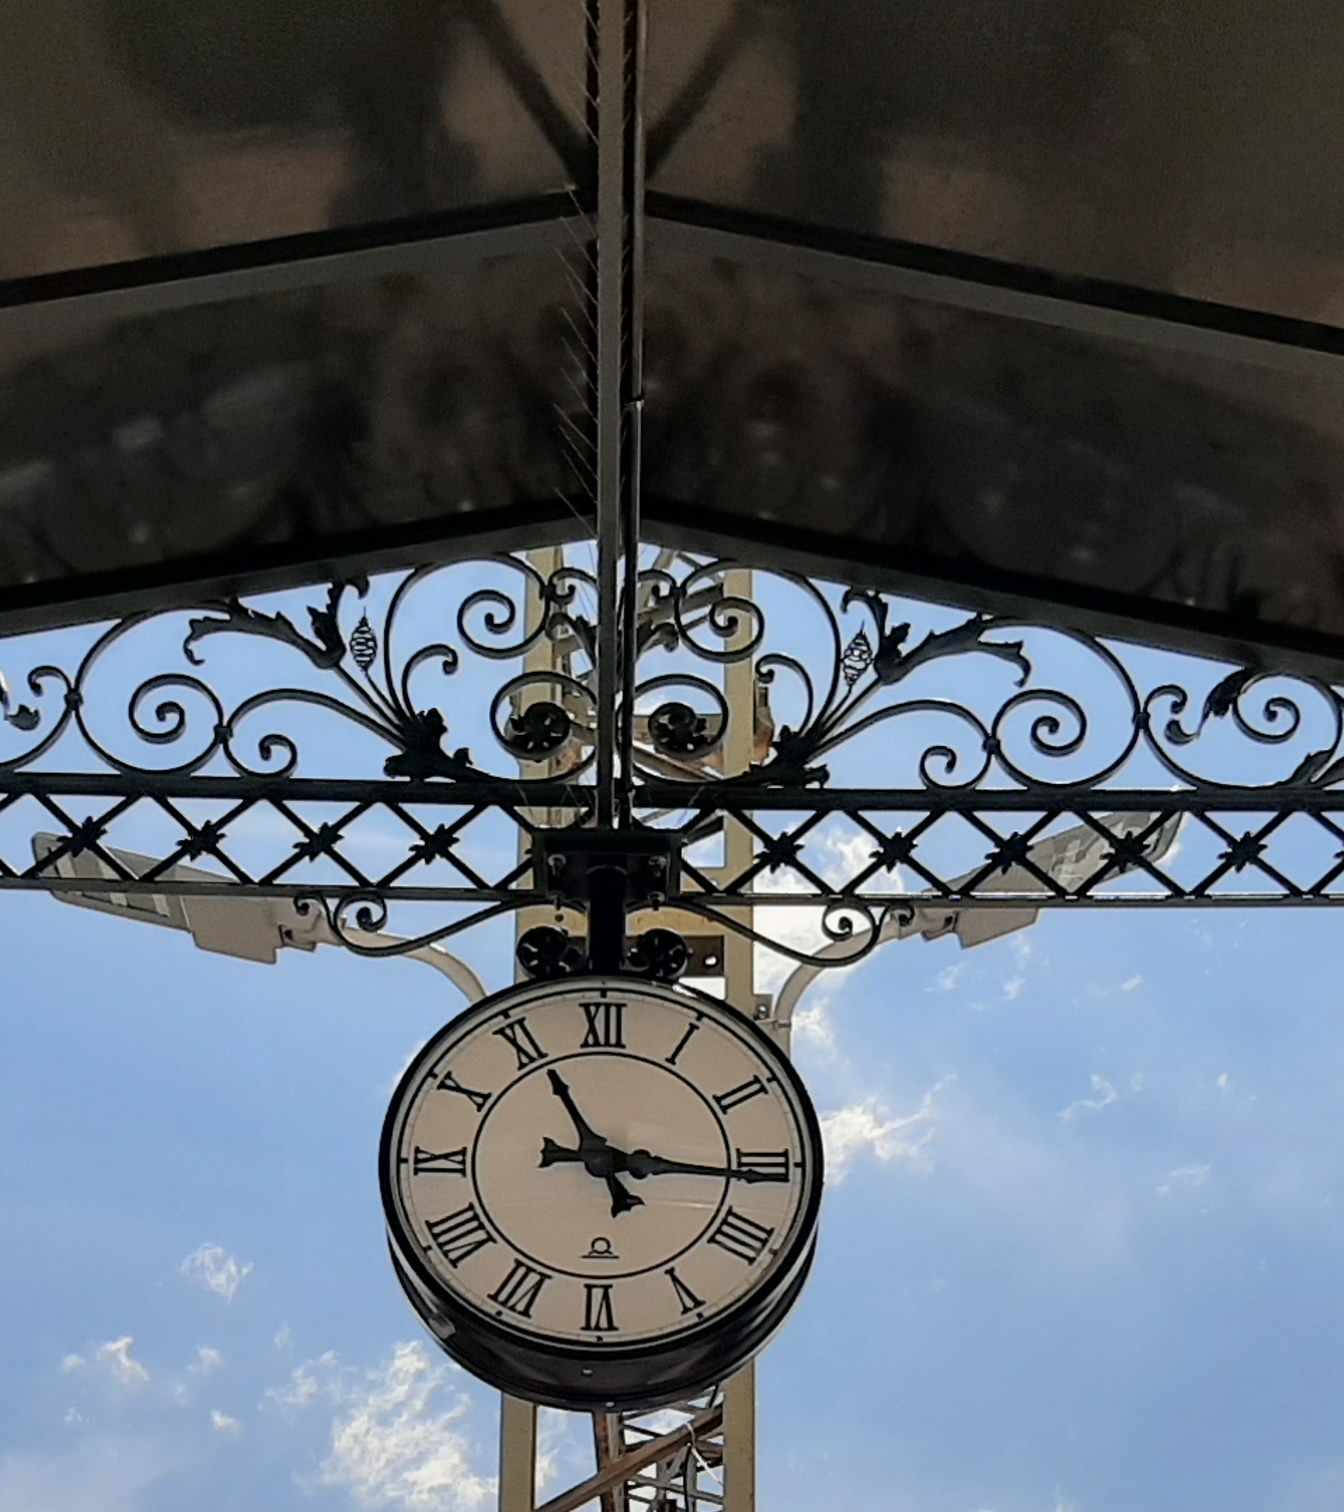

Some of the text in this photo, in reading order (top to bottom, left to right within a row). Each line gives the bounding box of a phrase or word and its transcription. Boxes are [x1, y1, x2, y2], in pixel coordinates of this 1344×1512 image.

[493, 1017, 548, 1069] XI
[579, 1003, 626, 1048] XII
[665, 1022, 700, 1065] I
[436, 1071, 492, 1112] X
[713, 1074, 768, 1114] II
[414, 1145, 467, 1177] IX
[736, 1148, 790, 1183] III
[425, 1203, 497, 1268] VIII
[707, 1206, 774, 1265] IIII
[487, 1259, 552, 1318] VII
[580, 1283, 619, 1331] VI
[664, 1267, 706, 1315] V
